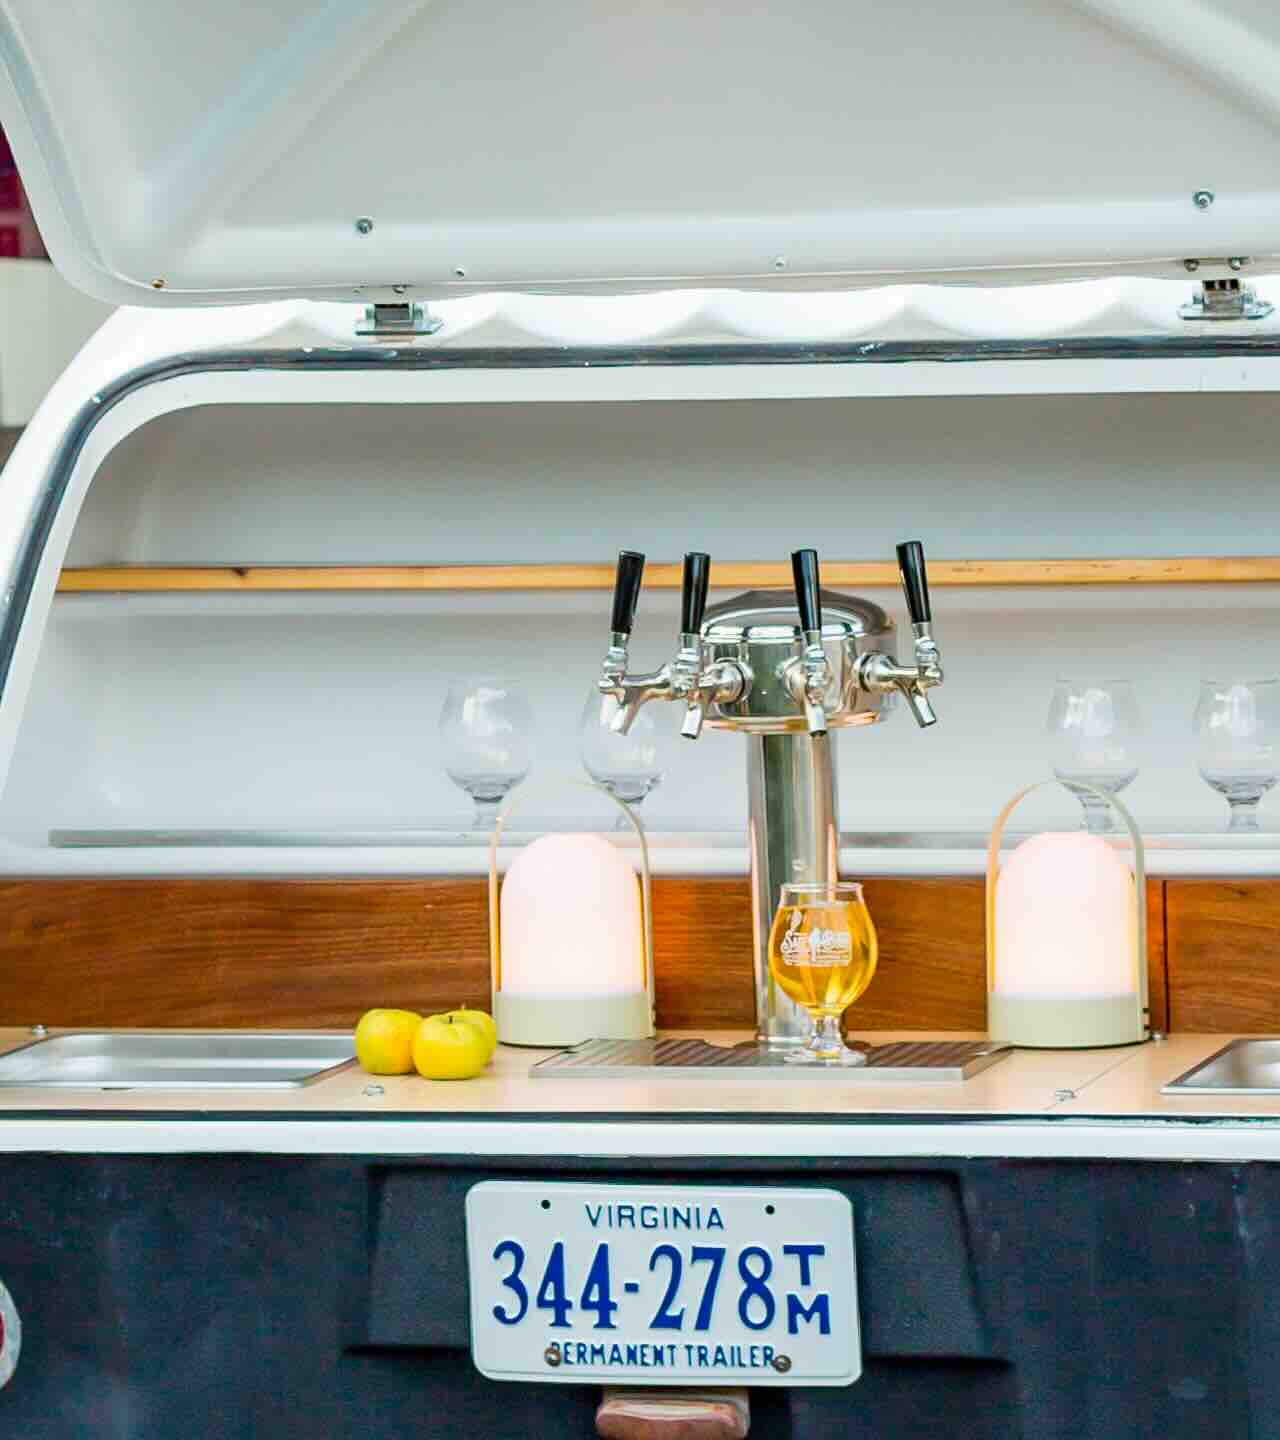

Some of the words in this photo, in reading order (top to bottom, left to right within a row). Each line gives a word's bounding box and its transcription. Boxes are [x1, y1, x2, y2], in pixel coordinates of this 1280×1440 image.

[586, 1204, 725, 1229] VIRGINIA
[492, 1240, 776, 1331] 344-278
[685, 1343, 775, 1367] TRAILER
